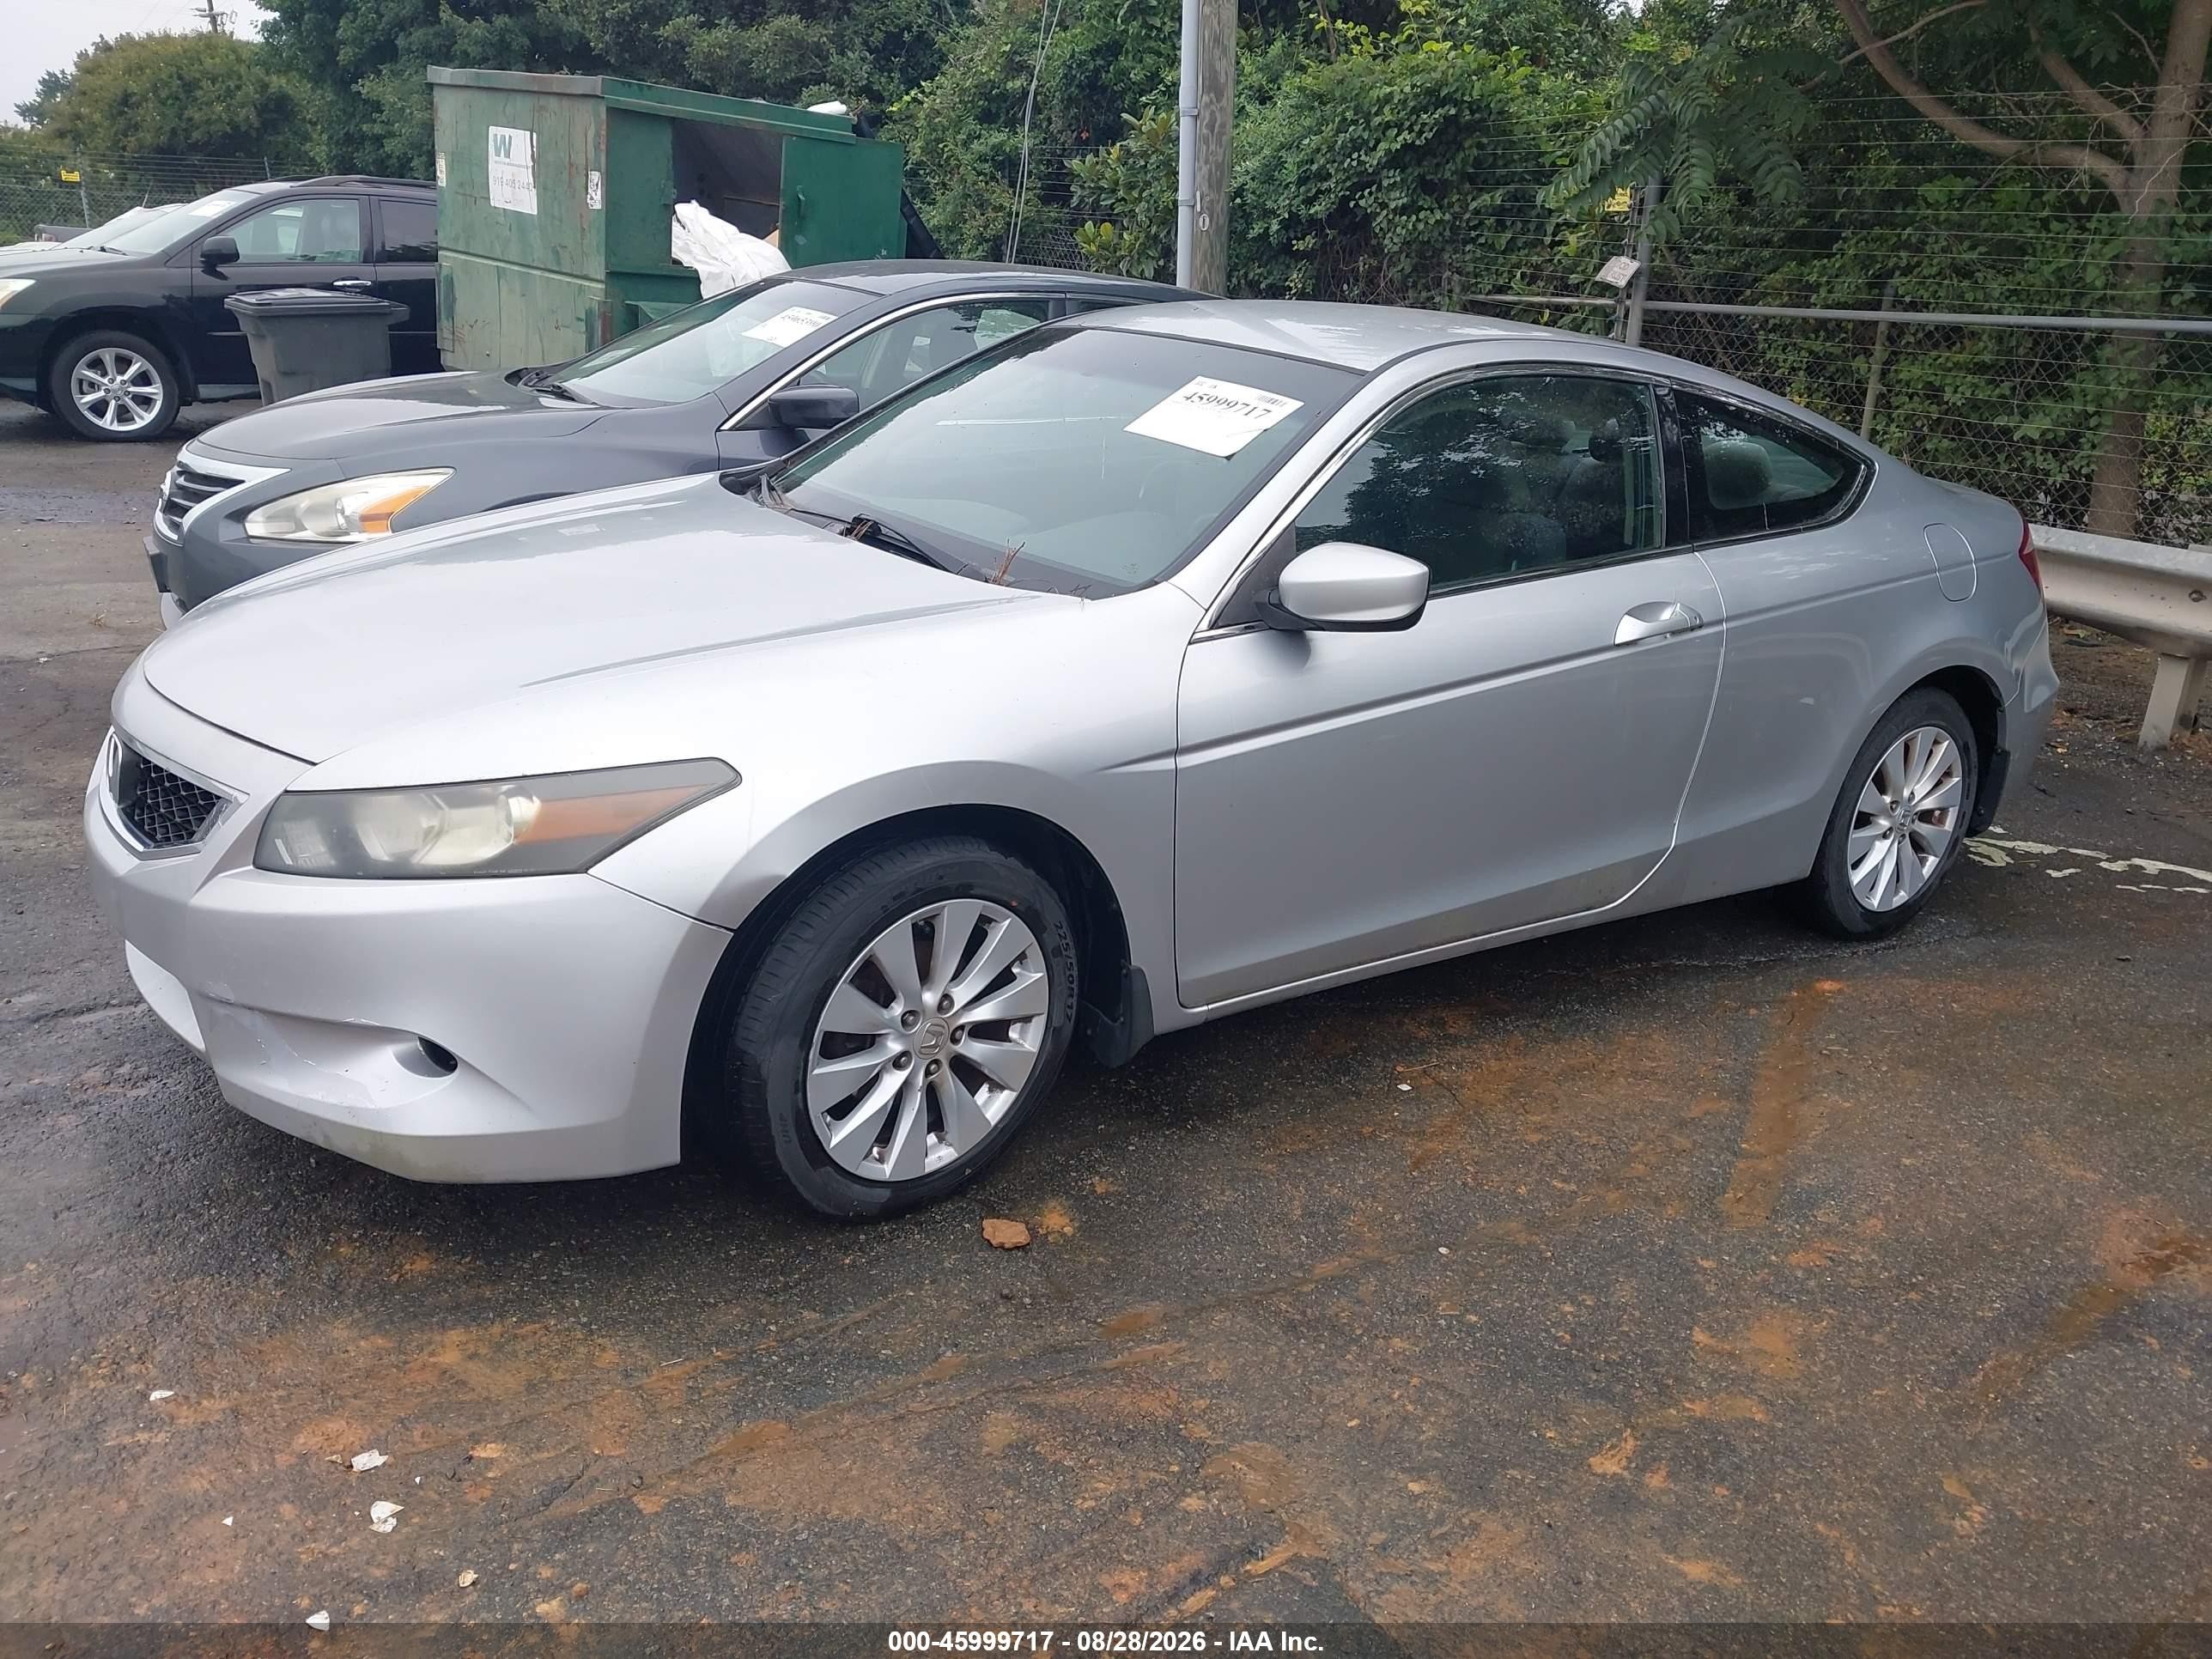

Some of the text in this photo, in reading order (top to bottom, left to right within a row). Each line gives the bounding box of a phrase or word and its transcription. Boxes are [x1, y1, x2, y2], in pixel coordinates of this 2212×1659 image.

[493, 133, 513, 159] W
[1183, 391, 1273, 419] 45999717
[1053, 921, 1075, 1024] 225/50R17
